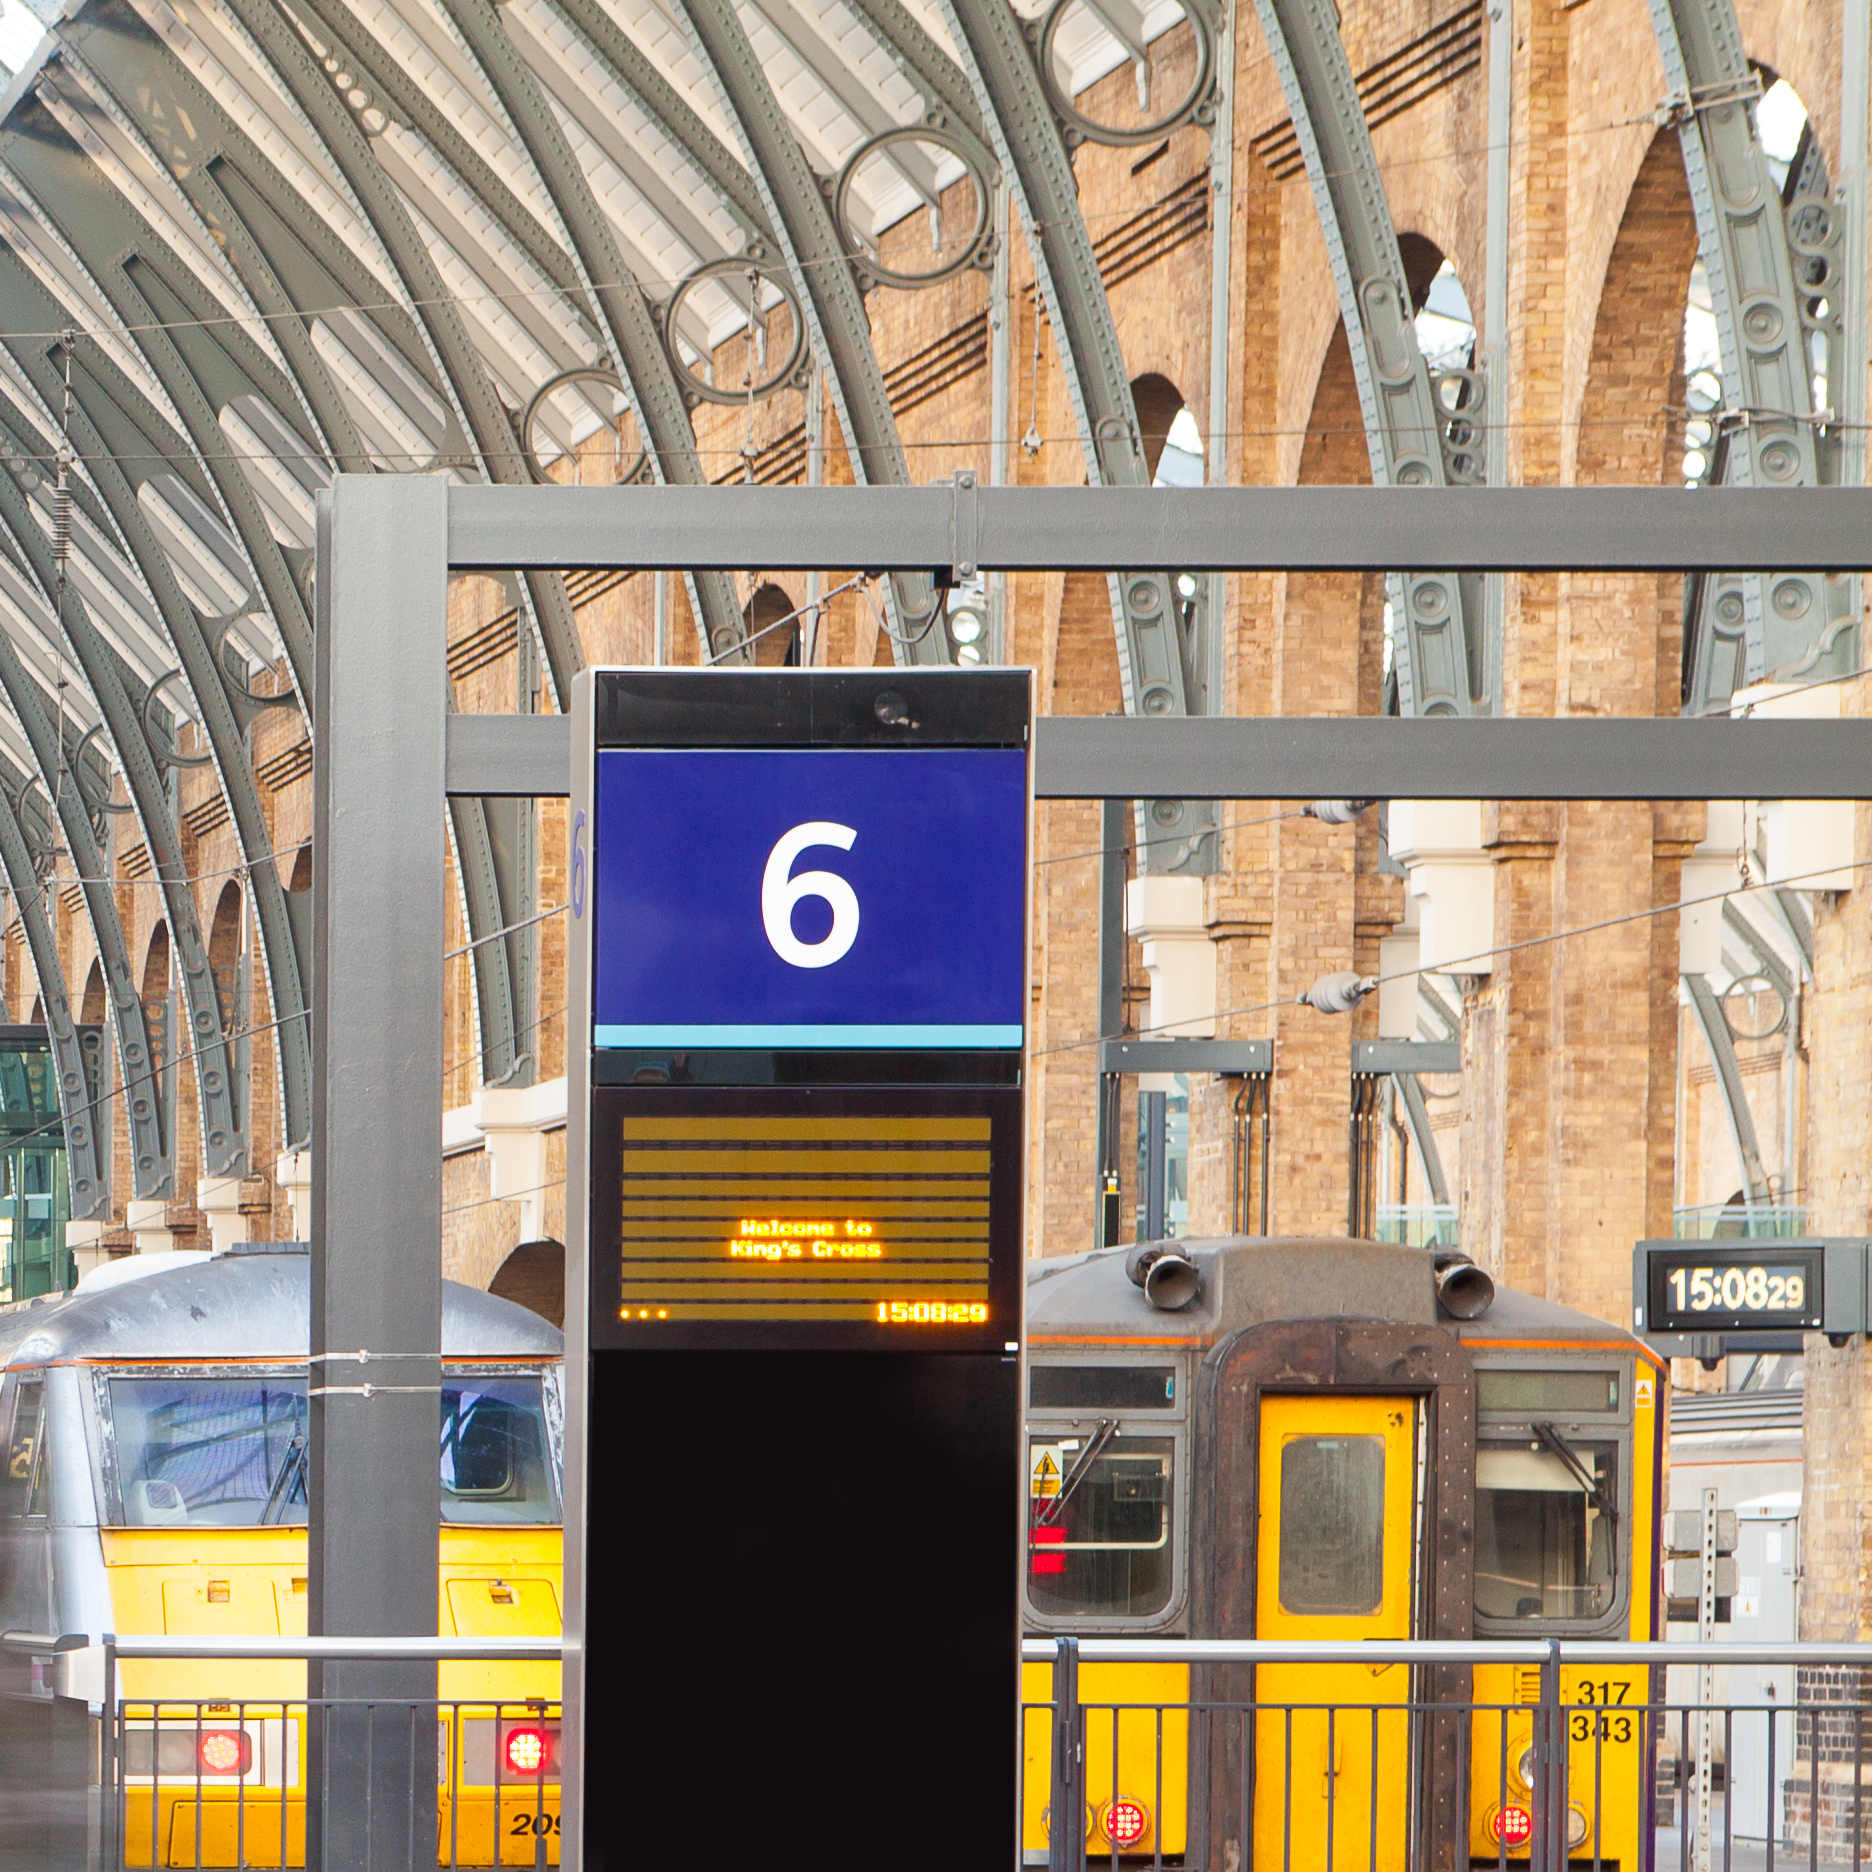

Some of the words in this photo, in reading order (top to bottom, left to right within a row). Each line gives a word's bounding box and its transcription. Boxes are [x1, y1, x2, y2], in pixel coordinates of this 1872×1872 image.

[761, 821, 860, 969] 6
[741, 1219, 834, 1237] Welcome
[845, 1219, 872, 1237] to
[730, 1240, 802, 1261] King's
[812, 1240, 883, 1258] Cross
[877, 1302, 988, 1323] 15:08:29
[1578, 1681, 1631, 1705] 317
[1572, 1715, 1631, 1743] 343
